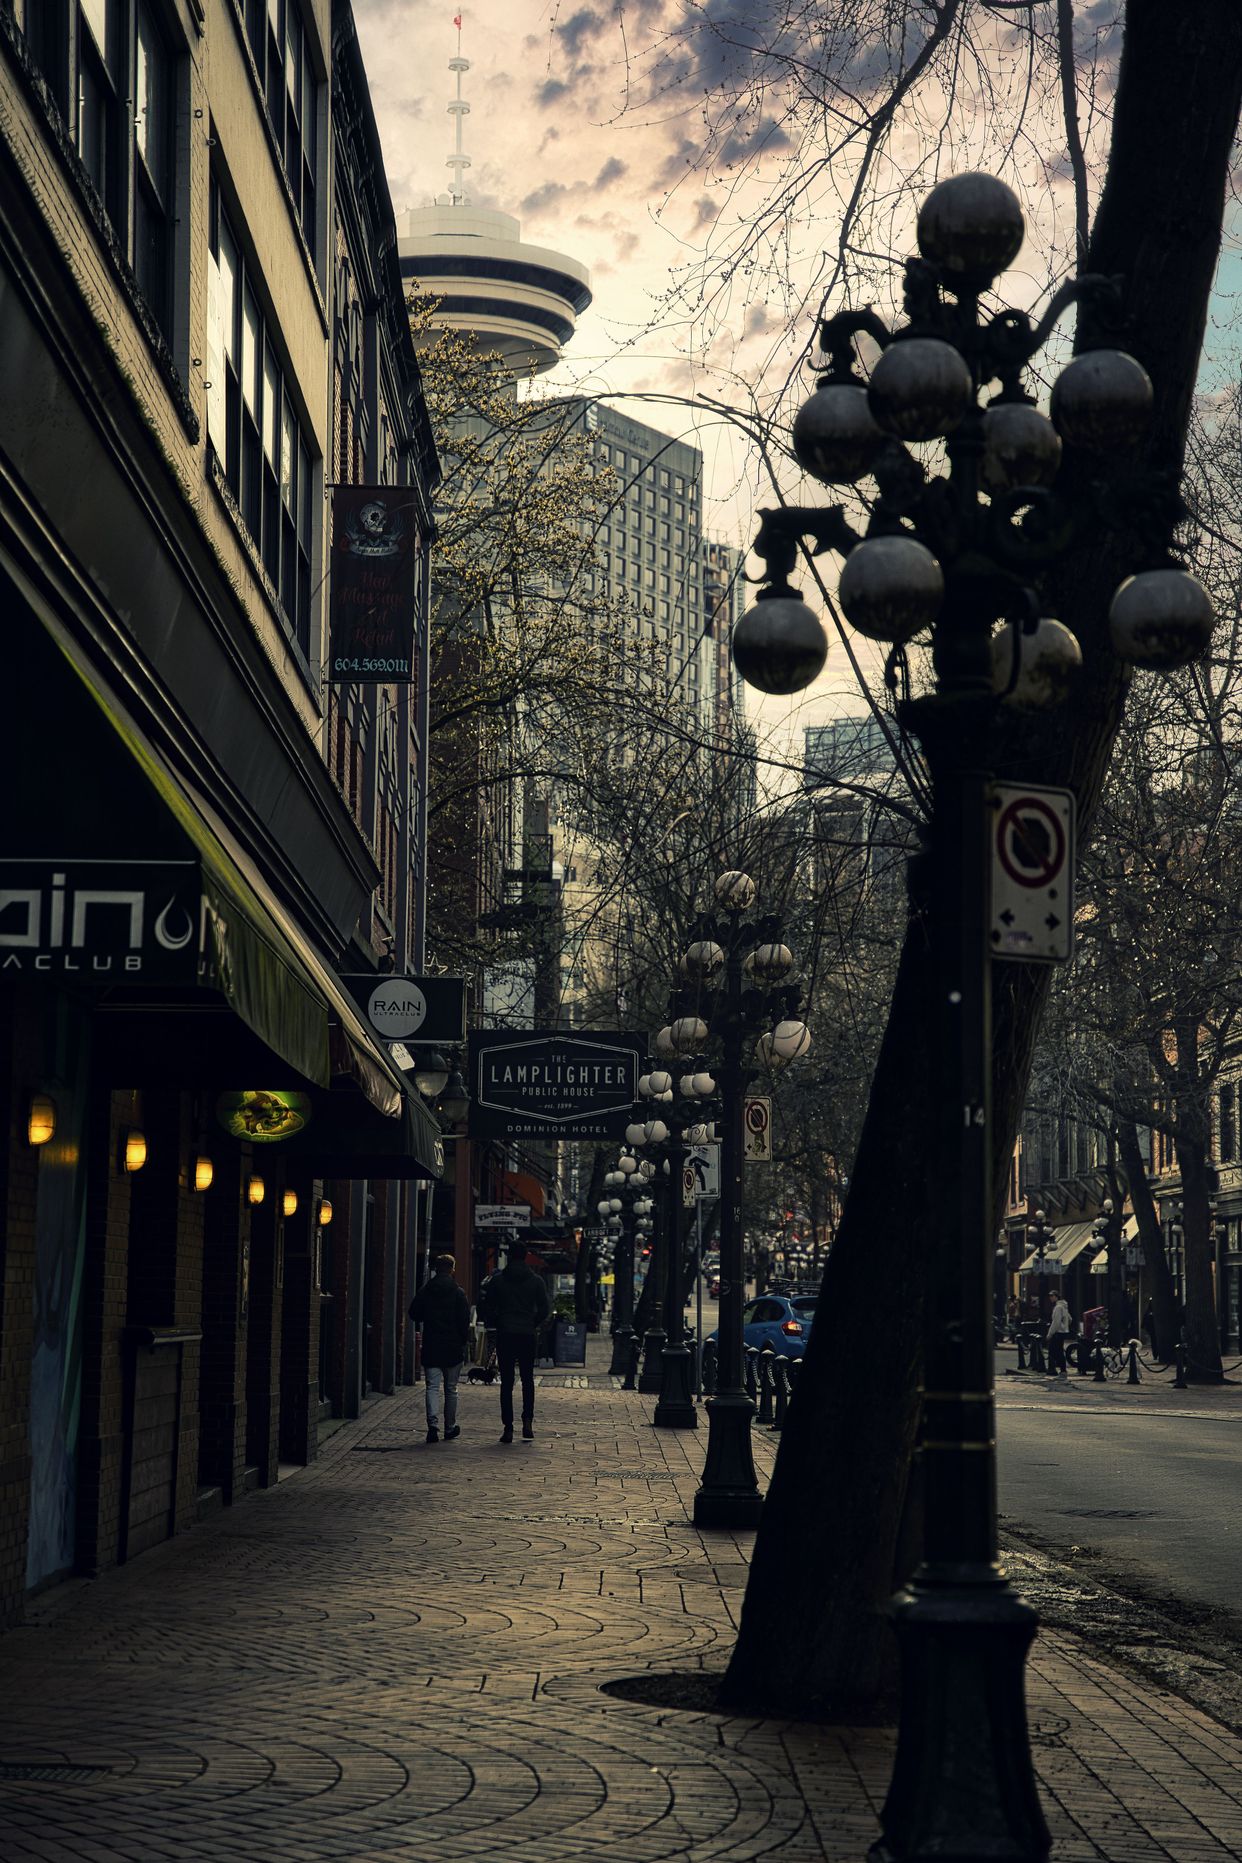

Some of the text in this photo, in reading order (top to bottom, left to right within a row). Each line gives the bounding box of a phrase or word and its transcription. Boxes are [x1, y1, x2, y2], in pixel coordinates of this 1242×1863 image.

[374, 1000, 421, 1011] RAIN
[551, 1054, 567, 1063] THE
[491, 1065, 627, 1085] LAMPLIGHTER
[521, 1087, 595, 1097] PUBLIC HOUSE
[507, 1124, 608, 1134] DOMINION HOTEL
